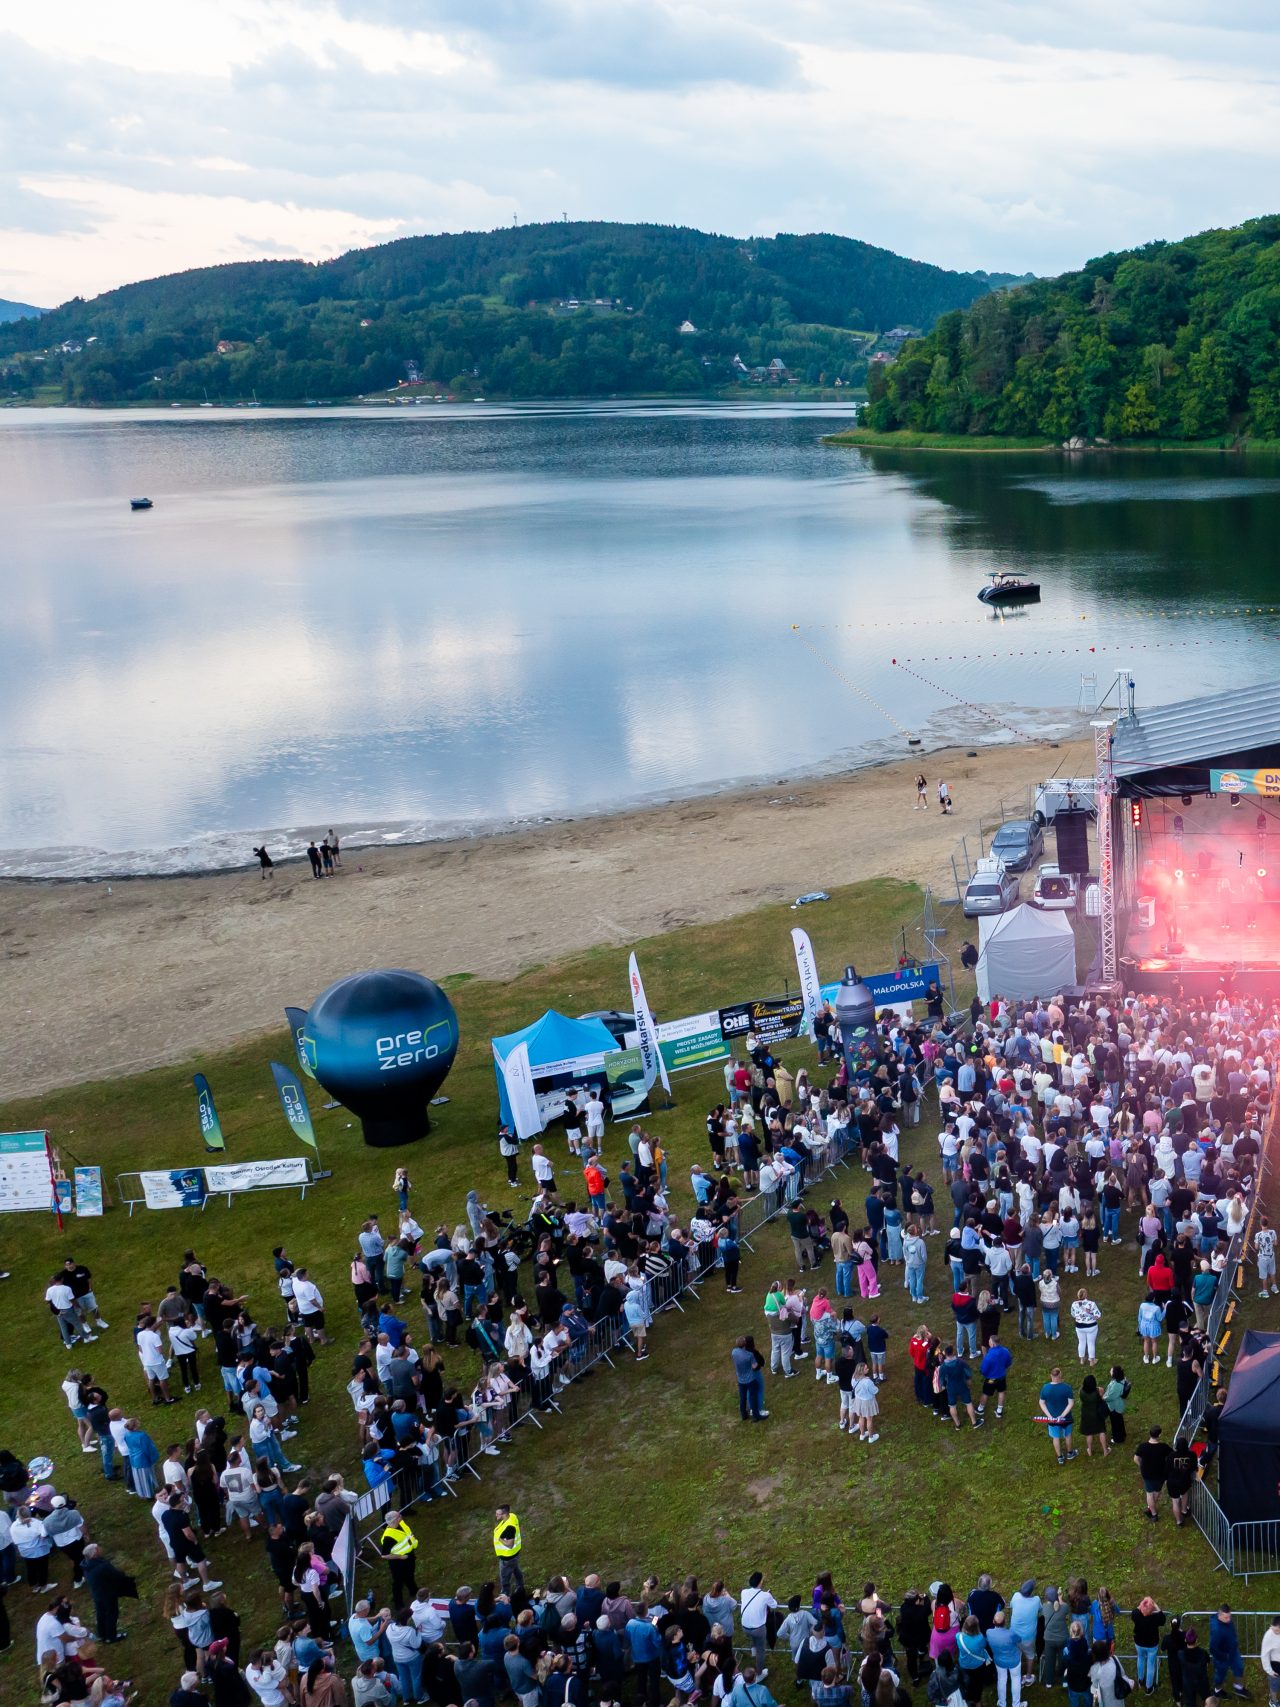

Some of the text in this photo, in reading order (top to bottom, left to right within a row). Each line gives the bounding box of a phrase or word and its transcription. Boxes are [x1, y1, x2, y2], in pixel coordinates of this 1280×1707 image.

[873, 980, 925, 995] MAŁOPOLSKA
[376, 1030, 422, 1056] pre
[676, 1032, 718, 1048] PROSTE ZASADY
[378, 1044, 438, 1071] zero
[675, 1046, 690, 1055] WIELE
